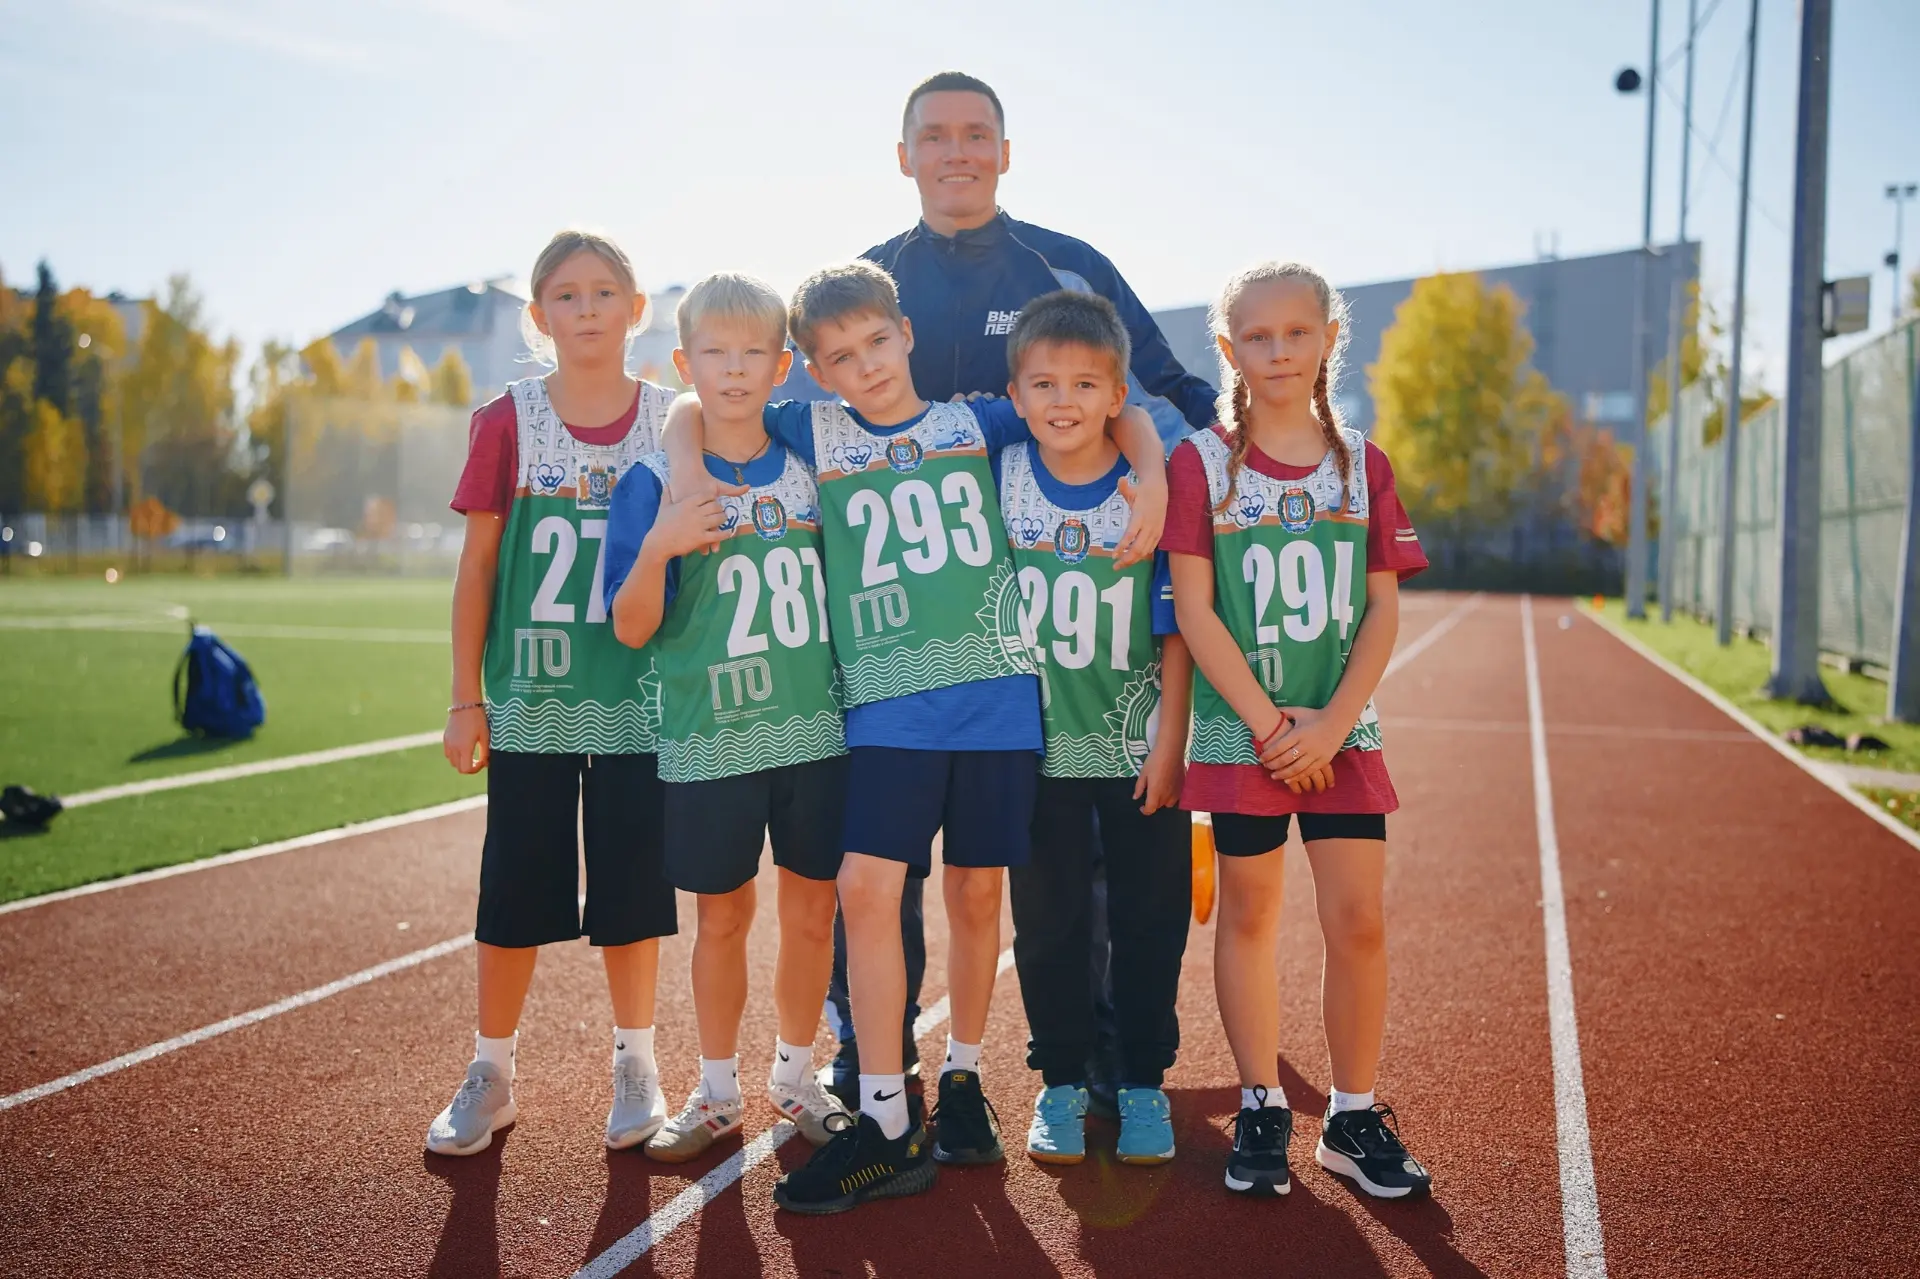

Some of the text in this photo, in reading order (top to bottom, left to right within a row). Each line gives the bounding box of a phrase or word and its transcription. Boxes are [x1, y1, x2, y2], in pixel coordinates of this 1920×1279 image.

[846, 471, 992, 588] 293
[717, 547, 829, 658] 281
[849, 583, 910, 638] ГТО
[1017, 566, 1134, 671] 291
[1242, 540, 1354, 645] 294
[513, 628, 571, 677] ГТО
[708, 656, 773, 710] ГТО
